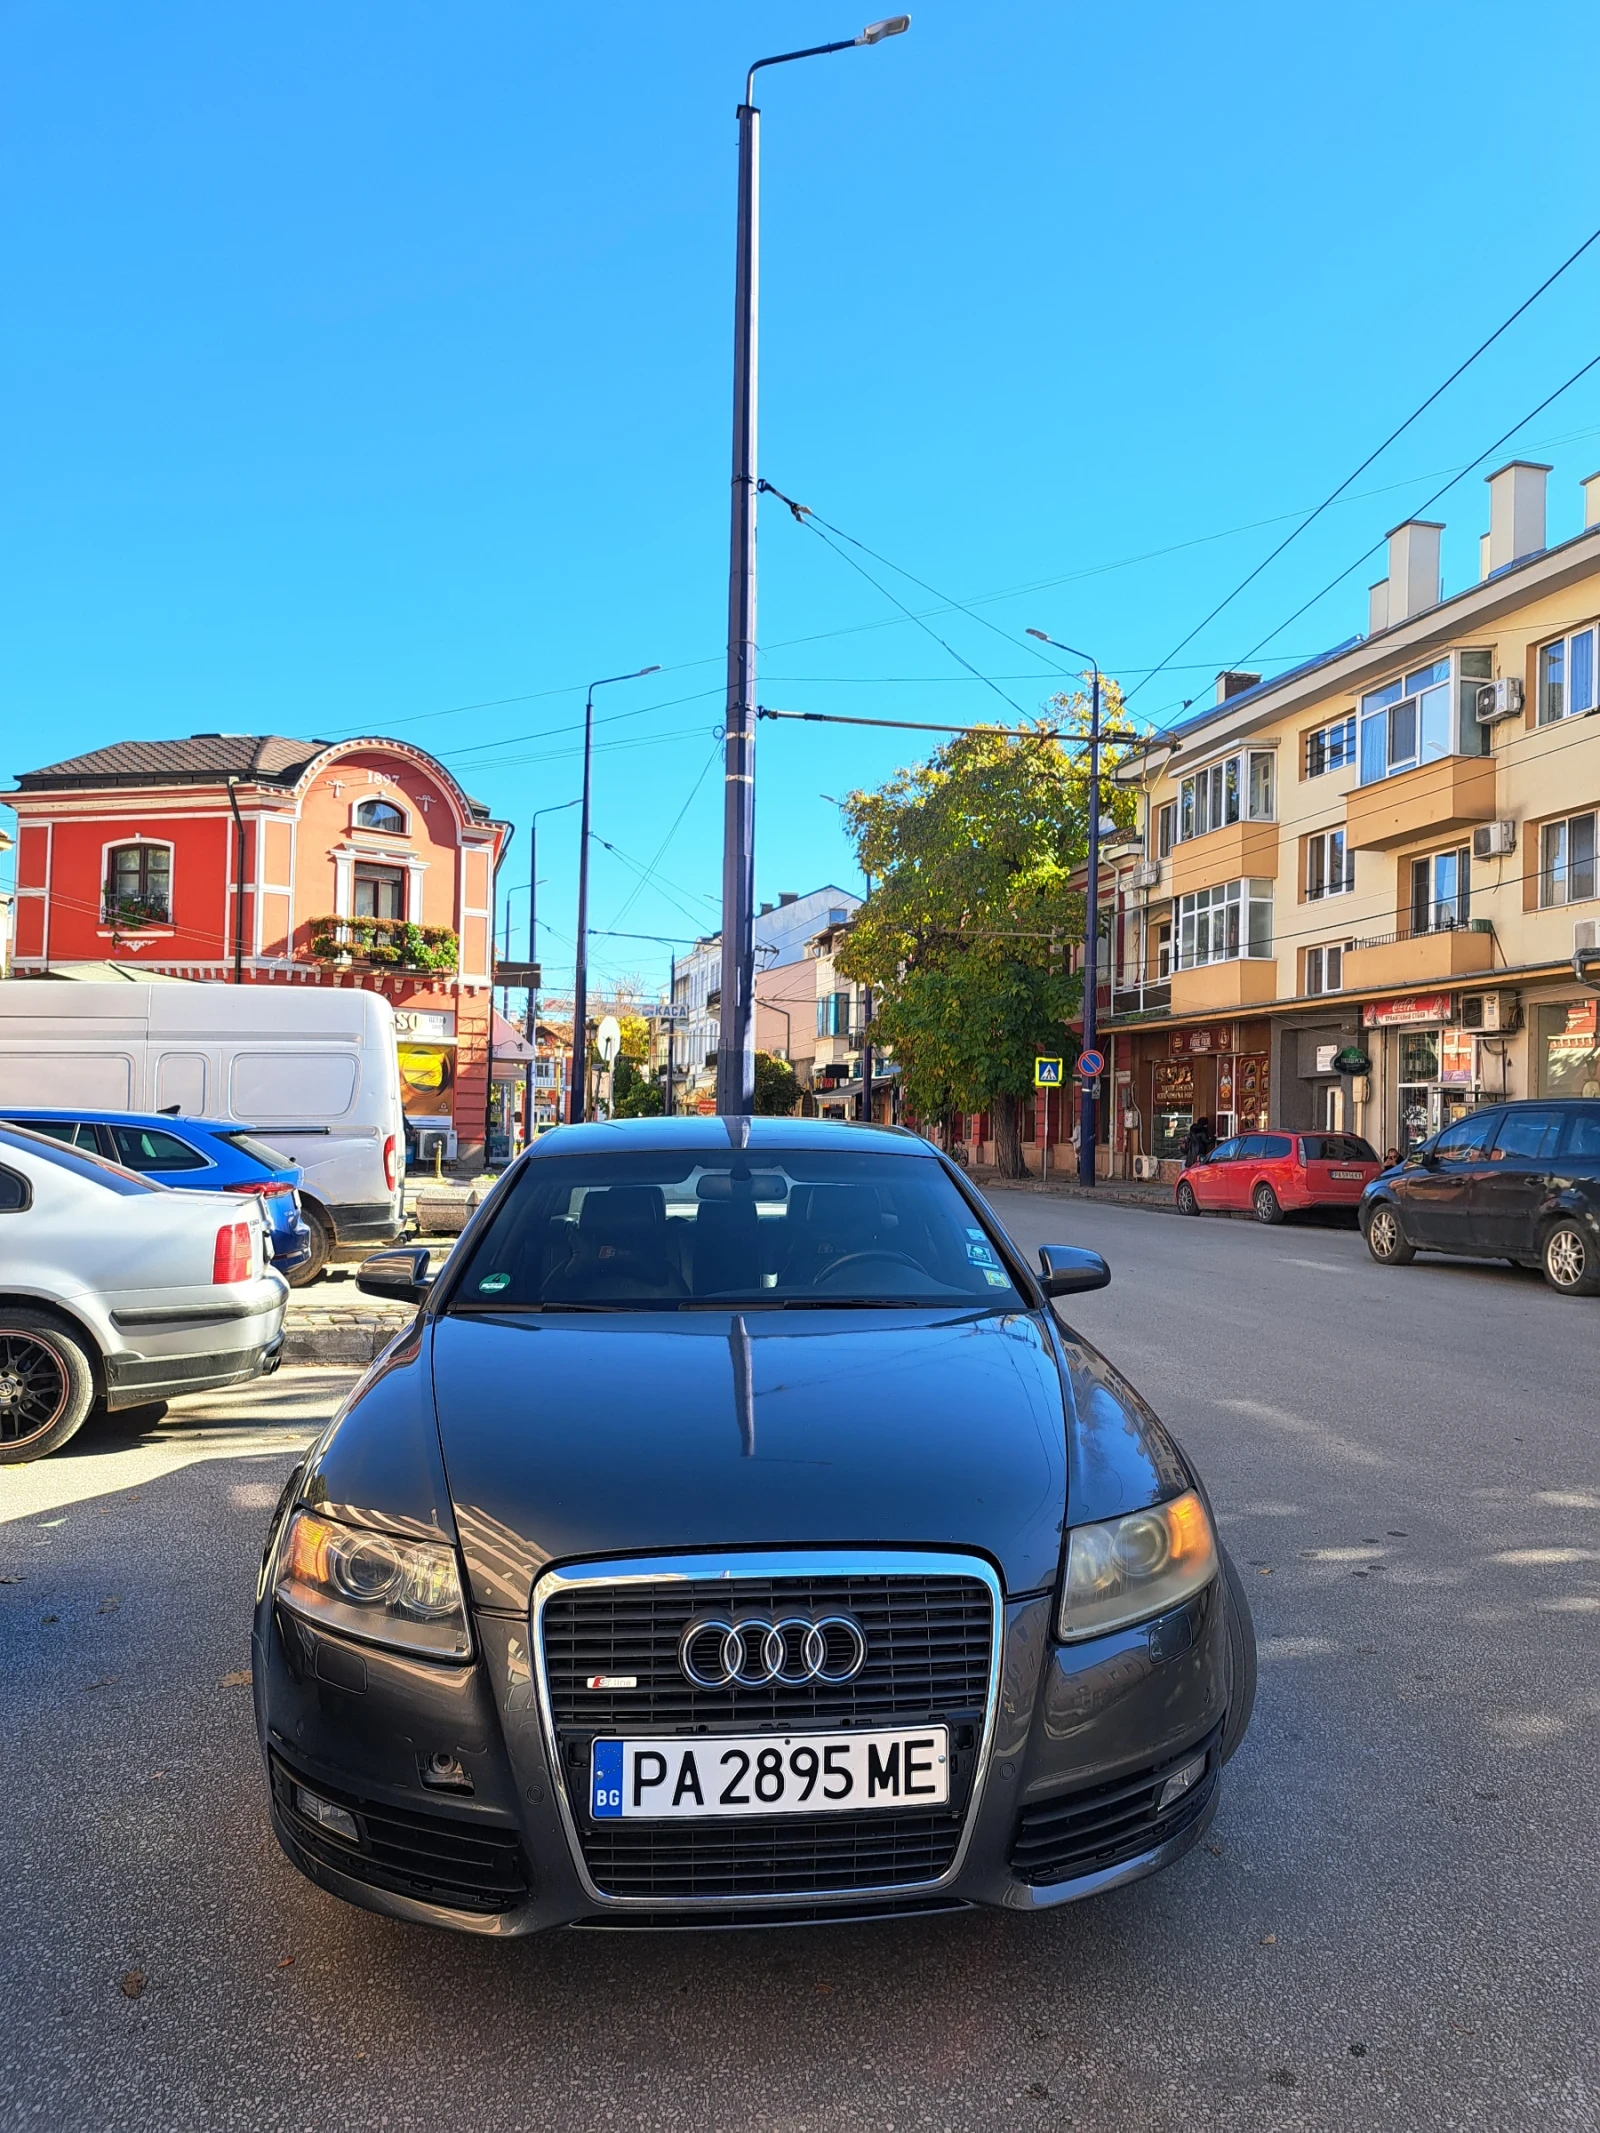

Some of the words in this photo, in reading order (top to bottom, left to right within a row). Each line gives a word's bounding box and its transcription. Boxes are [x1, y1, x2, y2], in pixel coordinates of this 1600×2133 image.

[367, 771, 400, 788] 1897
[655, 1006, 687, 1017] КАСА
[633, 1750, 705, 1807] PA
[719, 1744, 854, 1805] 2895
[868, 1738, 936, 1798] ME
[596, 1789, 620, 1807] BG
